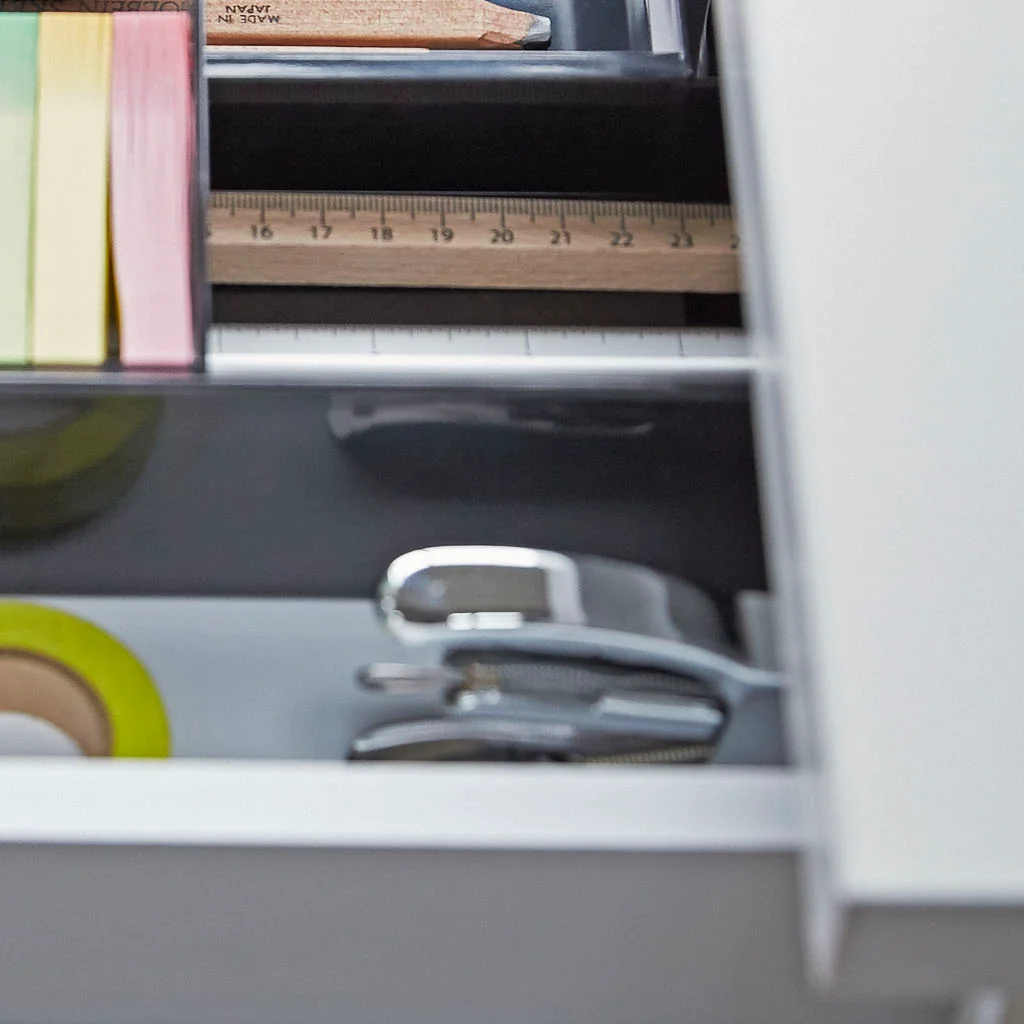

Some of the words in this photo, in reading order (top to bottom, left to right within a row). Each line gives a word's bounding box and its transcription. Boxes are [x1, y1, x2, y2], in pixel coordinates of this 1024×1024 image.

[226, 4, 272, 13] JAPAN
[217, 14, 233, 24] IN
[241, 15, 281, 24] MADE
[250, 224, 273, 240] 16
[311, 225, 332, 240] 17
[372, 226, 394, 241] 18
[432, 226, 454, 242] 19
[491, 228, 514, 244] 20
[550, 229, 571, 245] 21
[610, 231, 634, 247] 22
[671, 232, 695, 248] 23
